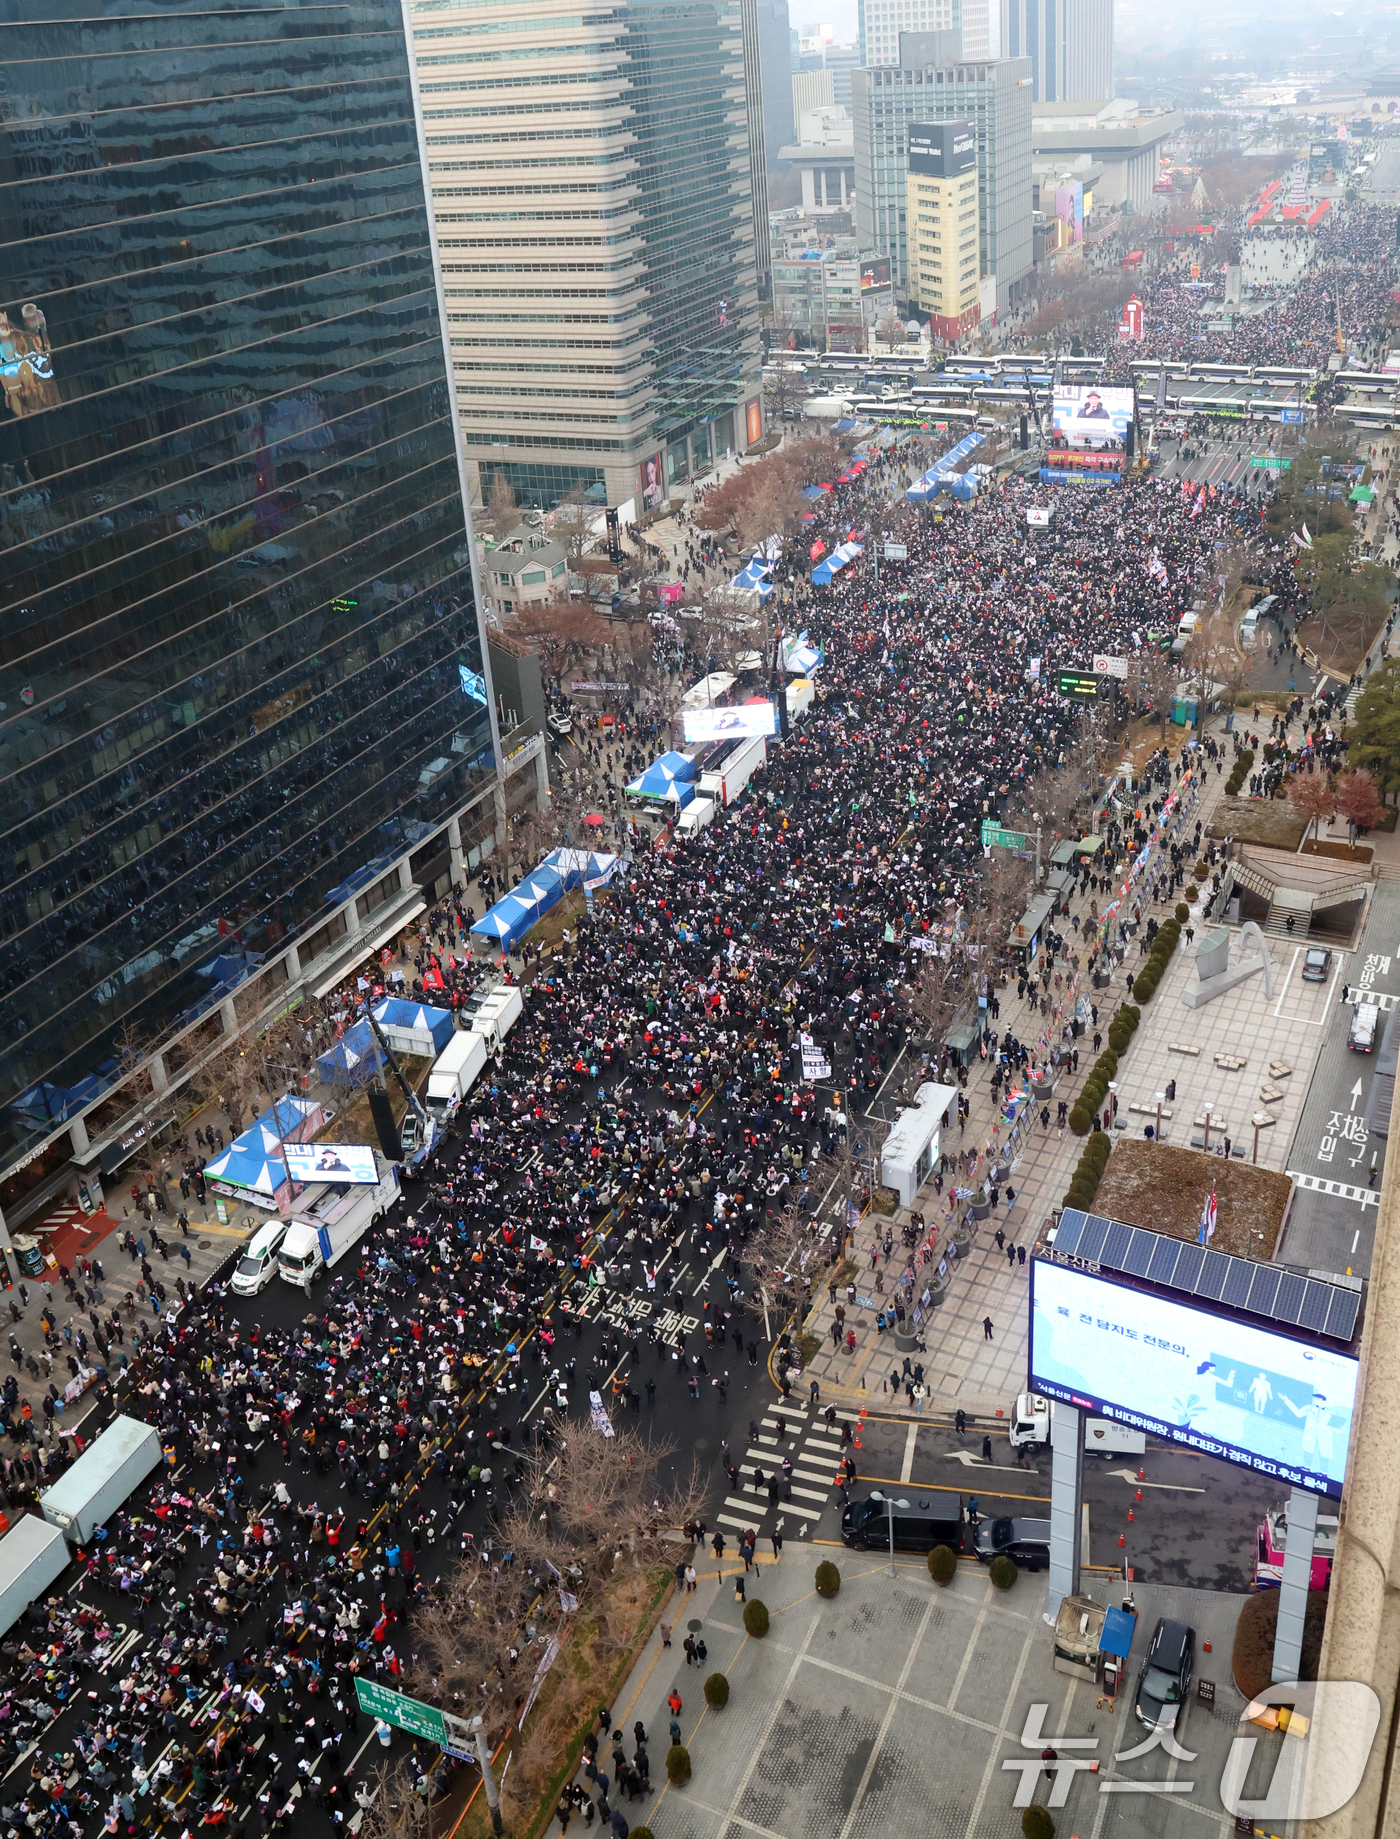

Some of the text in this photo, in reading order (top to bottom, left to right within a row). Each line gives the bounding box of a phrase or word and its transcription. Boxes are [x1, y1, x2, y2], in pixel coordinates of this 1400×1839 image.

[1038, 1246, 1102, 1276] 서울신문
[1172, 1429, 1228, 1458] 원내대표가
[1229, 1448, 1252, 1466] 겸직
[1253, 1458, 1277, 1475] 않고
[1277, 1467, 1302, 1484] 후보
[1303, 1475, 1328, 1493] 물색
